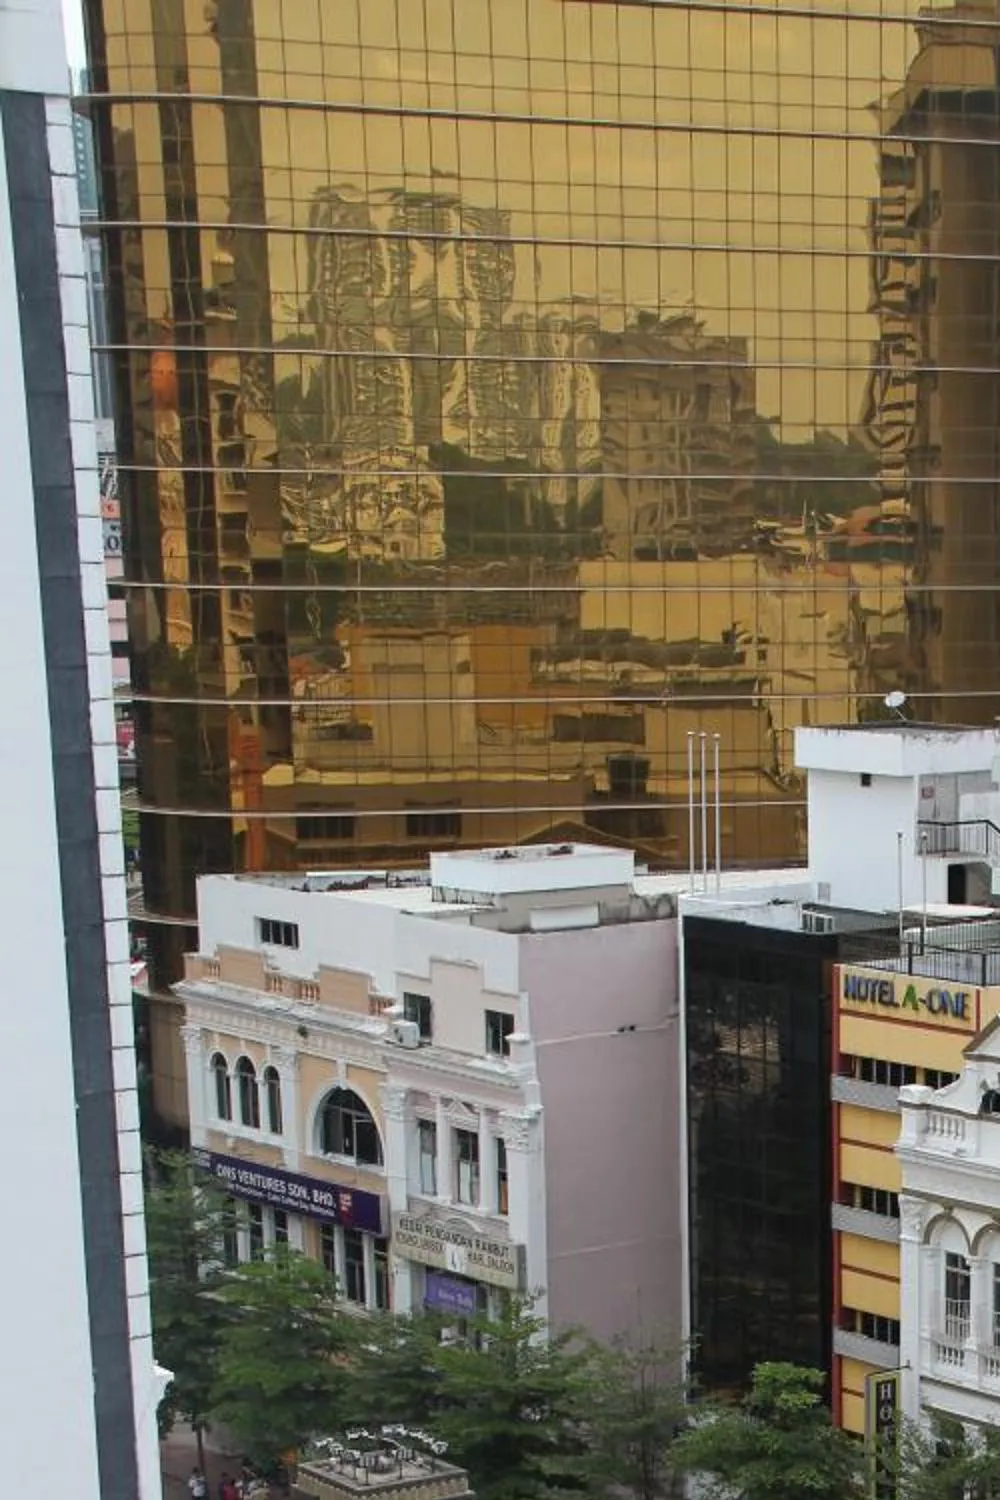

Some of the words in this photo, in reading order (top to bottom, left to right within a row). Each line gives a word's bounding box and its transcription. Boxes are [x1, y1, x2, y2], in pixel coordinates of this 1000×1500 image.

[844, 973, 900, 1008] HOTEL
[902, 983, 972, 1022] A-ONE
[237, 1169, 287, 1194] VENTURES
